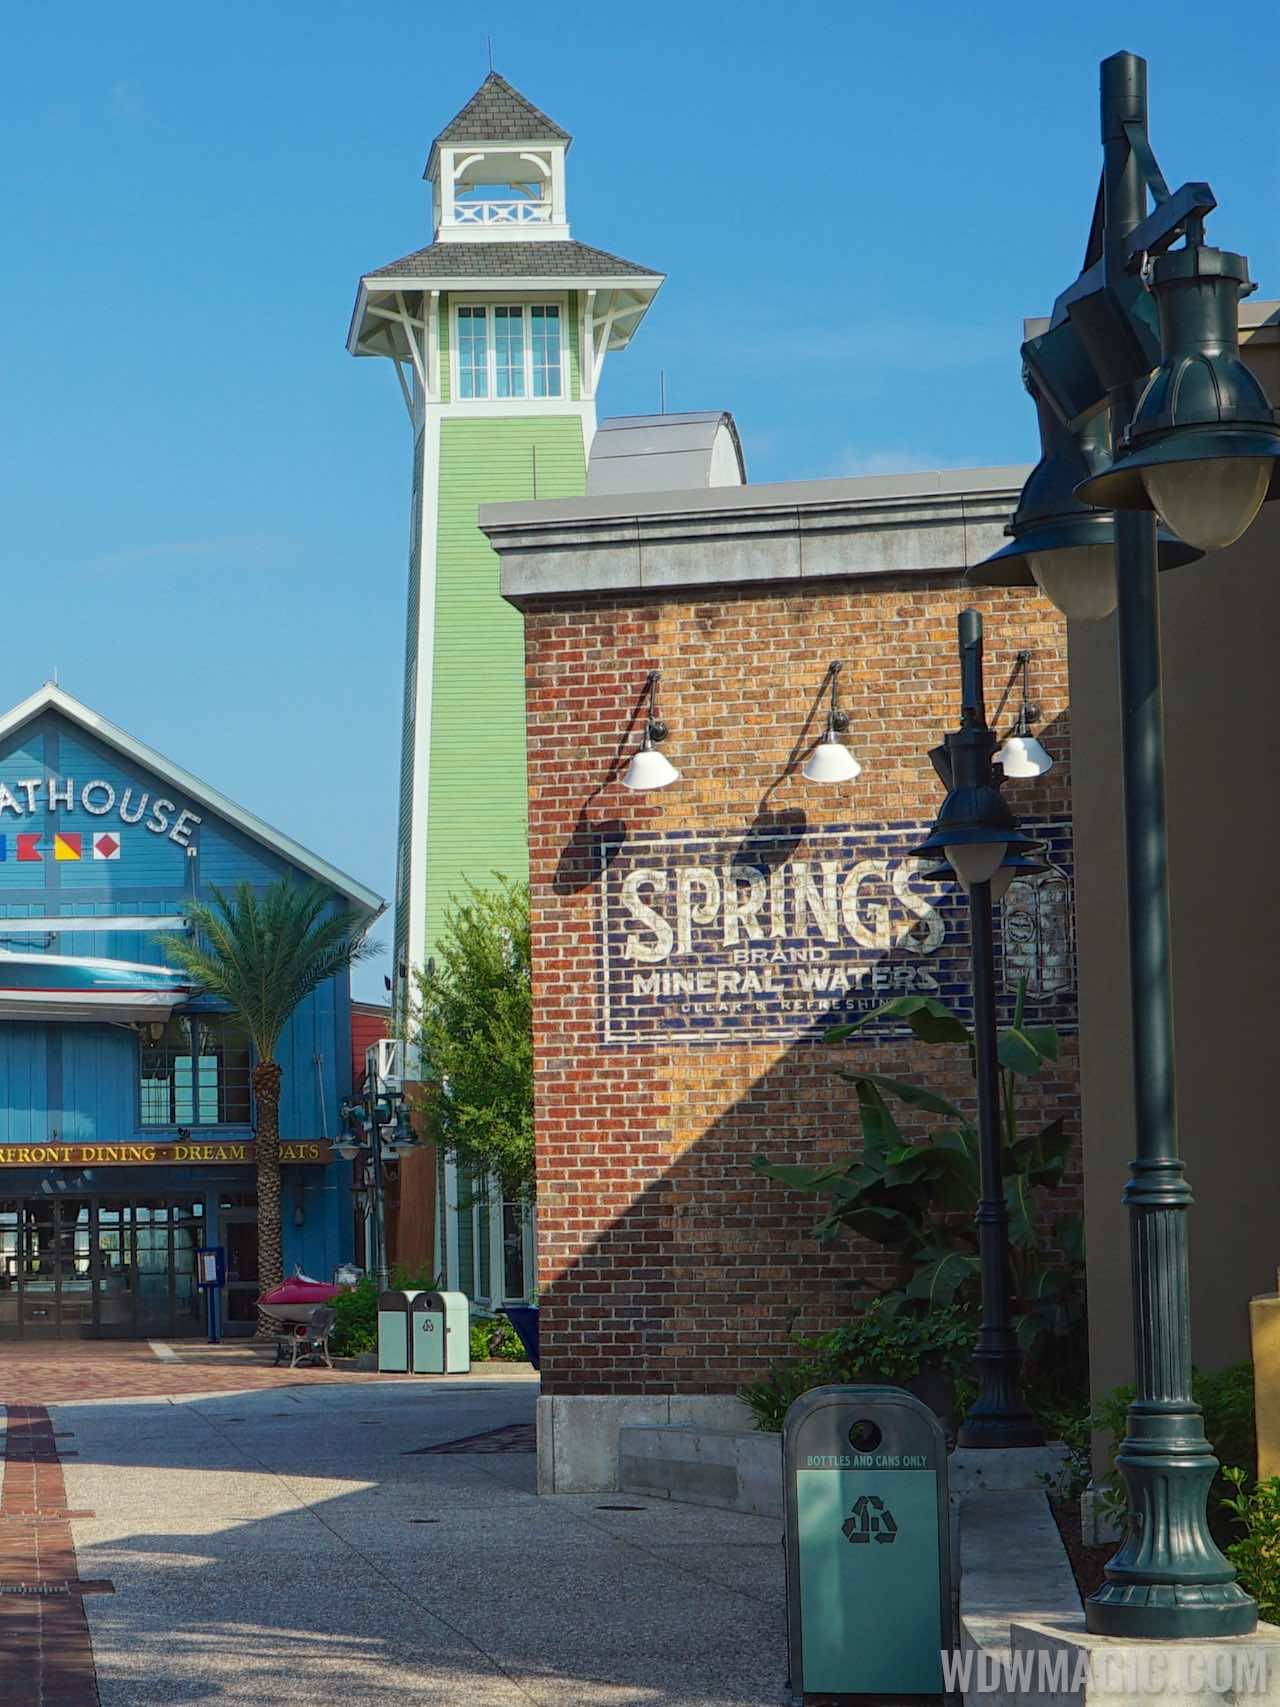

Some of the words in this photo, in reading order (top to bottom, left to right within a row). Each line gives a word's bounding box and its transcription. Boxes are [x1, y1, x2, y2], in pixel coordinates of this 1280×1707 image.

[622, 859, 946, 963] SPRINGS
[734, 947, 830, 965] BRAND
[632, 968, 784, 996] MINERAL
[797, 966, 939, 994] WATERS
[681, 1001, 742, 1013] CLEAR
[780, 997, 894, 1012] REFRESHIN
[80, 1146, 156, 1162] DINING
[174, 1145, 246, 1161] DREAM
[807, 1455, 851, 1467] BOTTLES
[853, 1455, 873, 1467] AND
[875, 1455, 900, 1467] CANS
[902, 1455, 928, 1467] ONLY
